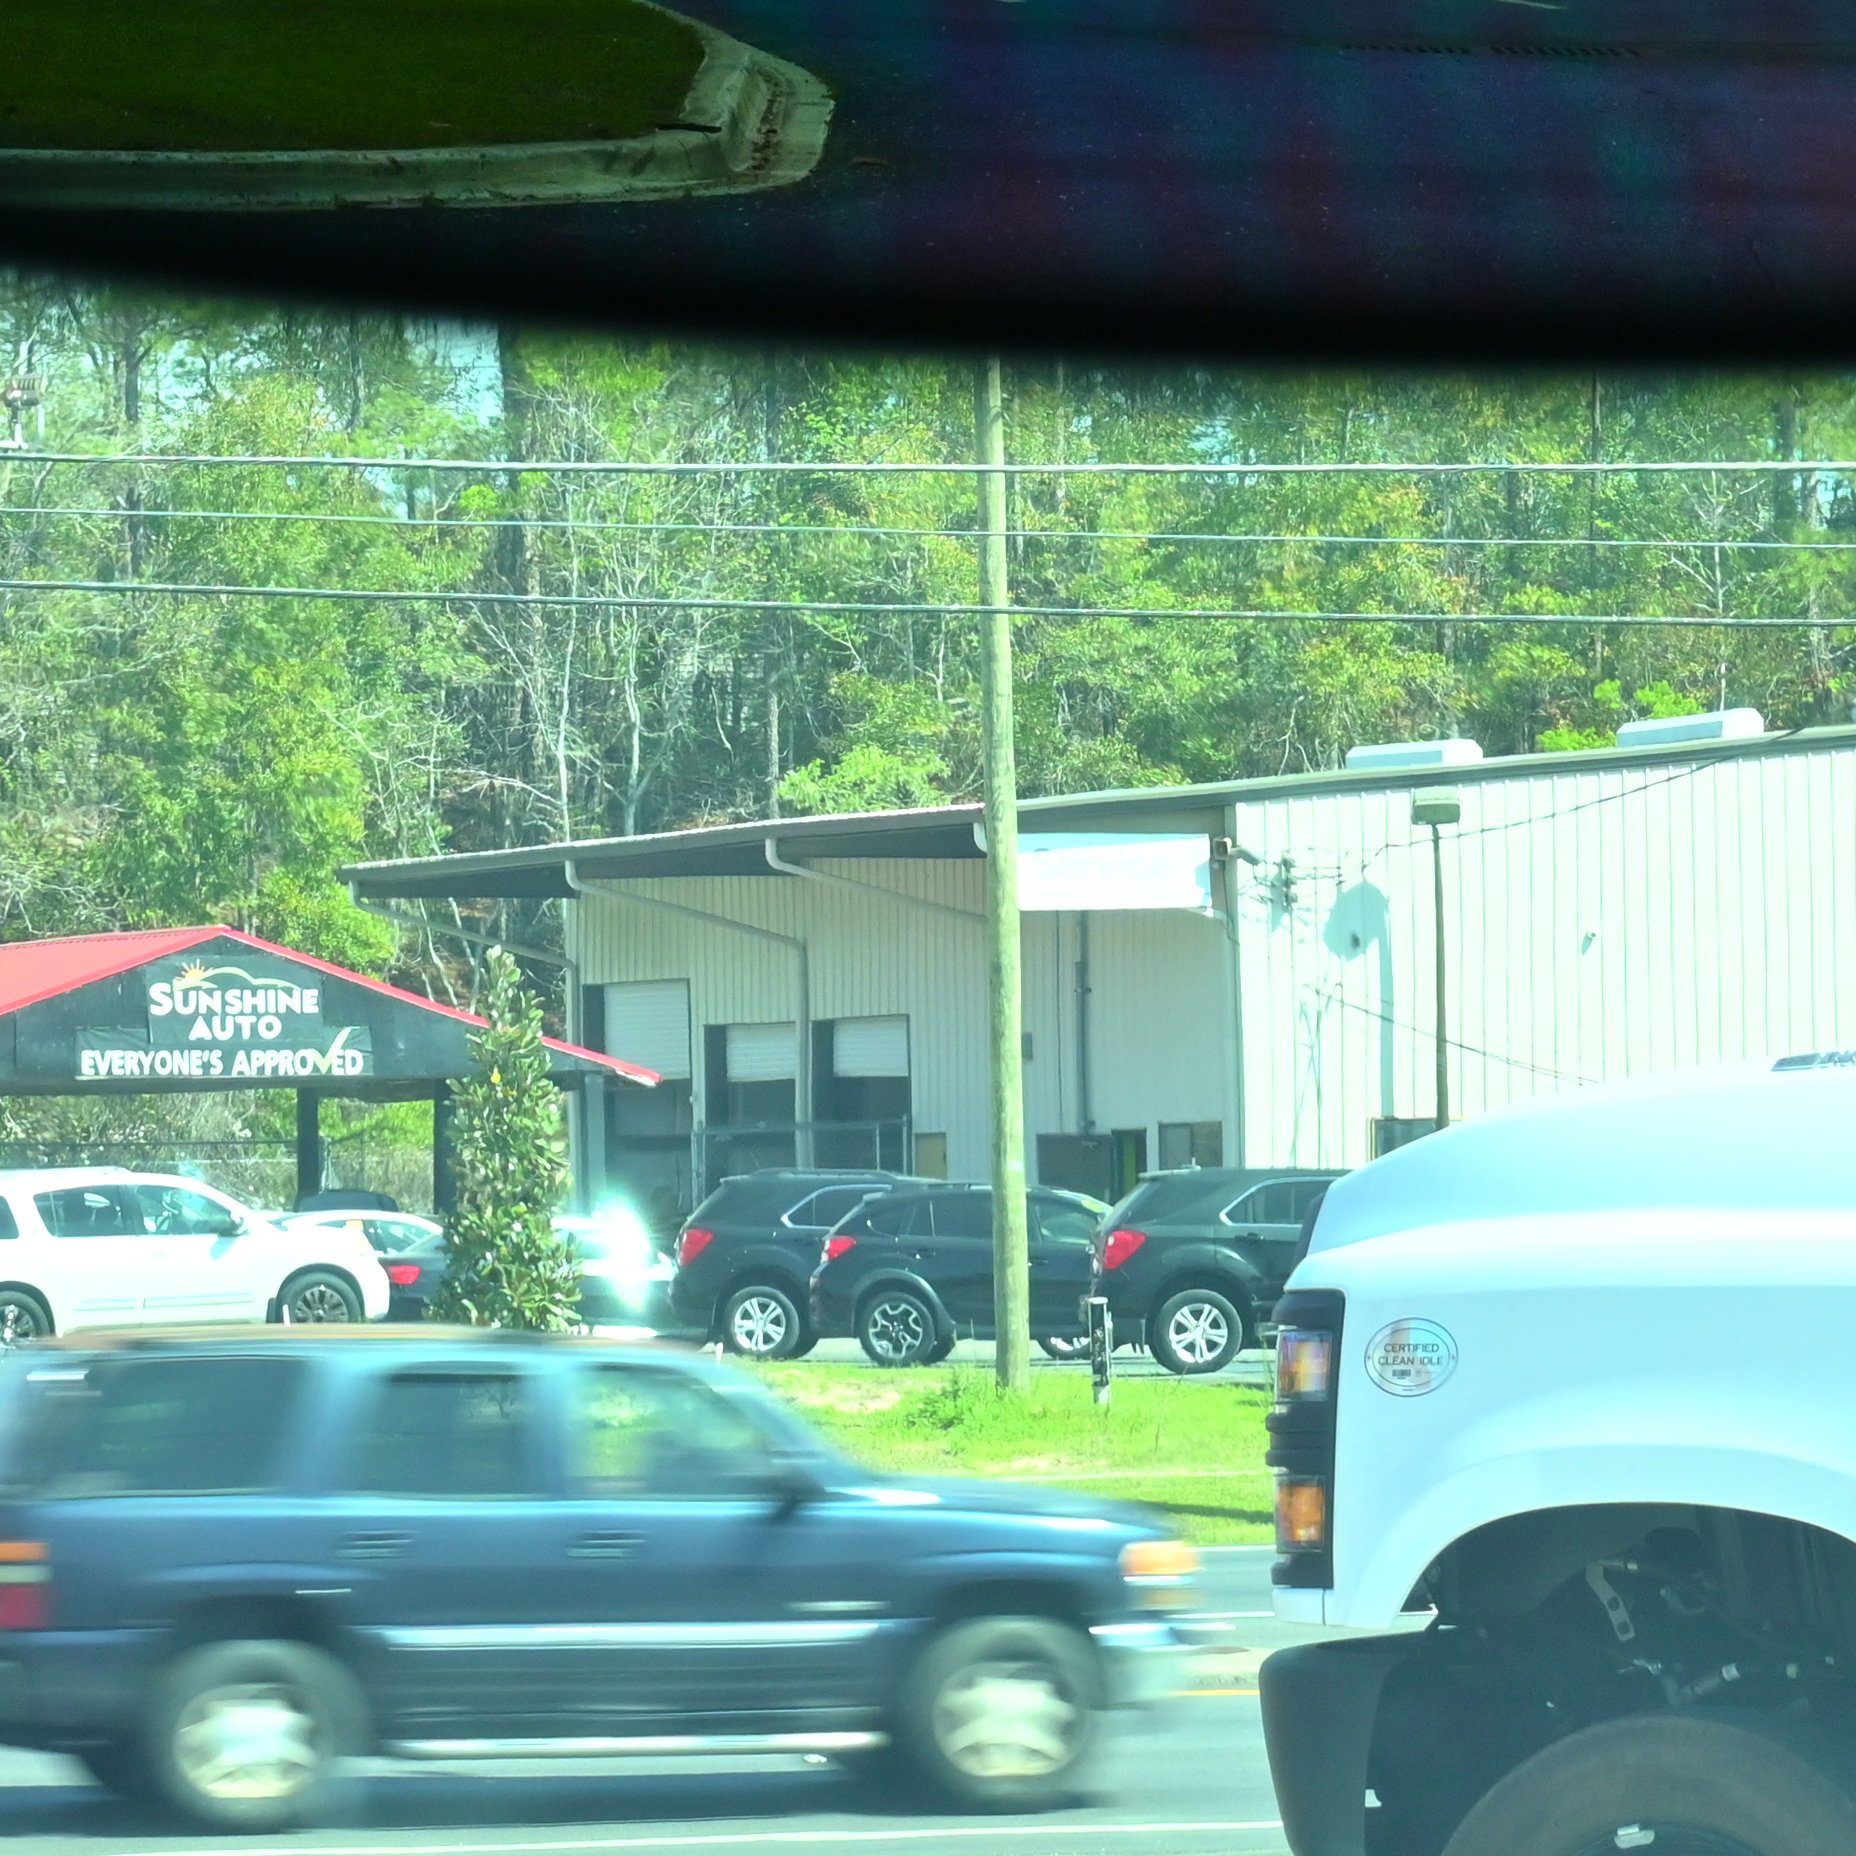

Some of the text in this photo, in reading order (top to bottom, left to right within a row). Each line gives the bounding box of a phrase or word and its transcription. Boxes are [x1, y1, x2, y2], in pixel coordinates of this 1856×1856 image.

[188, 1015, 282, 1041] AUTO
[80, 1026, 364, 1077] EVERYONE'S APPROVED
[1383, 1343, 1440, 1353] CERTIFIED
[1377, 1356, 1444, 1366] CLEAN IDLE
